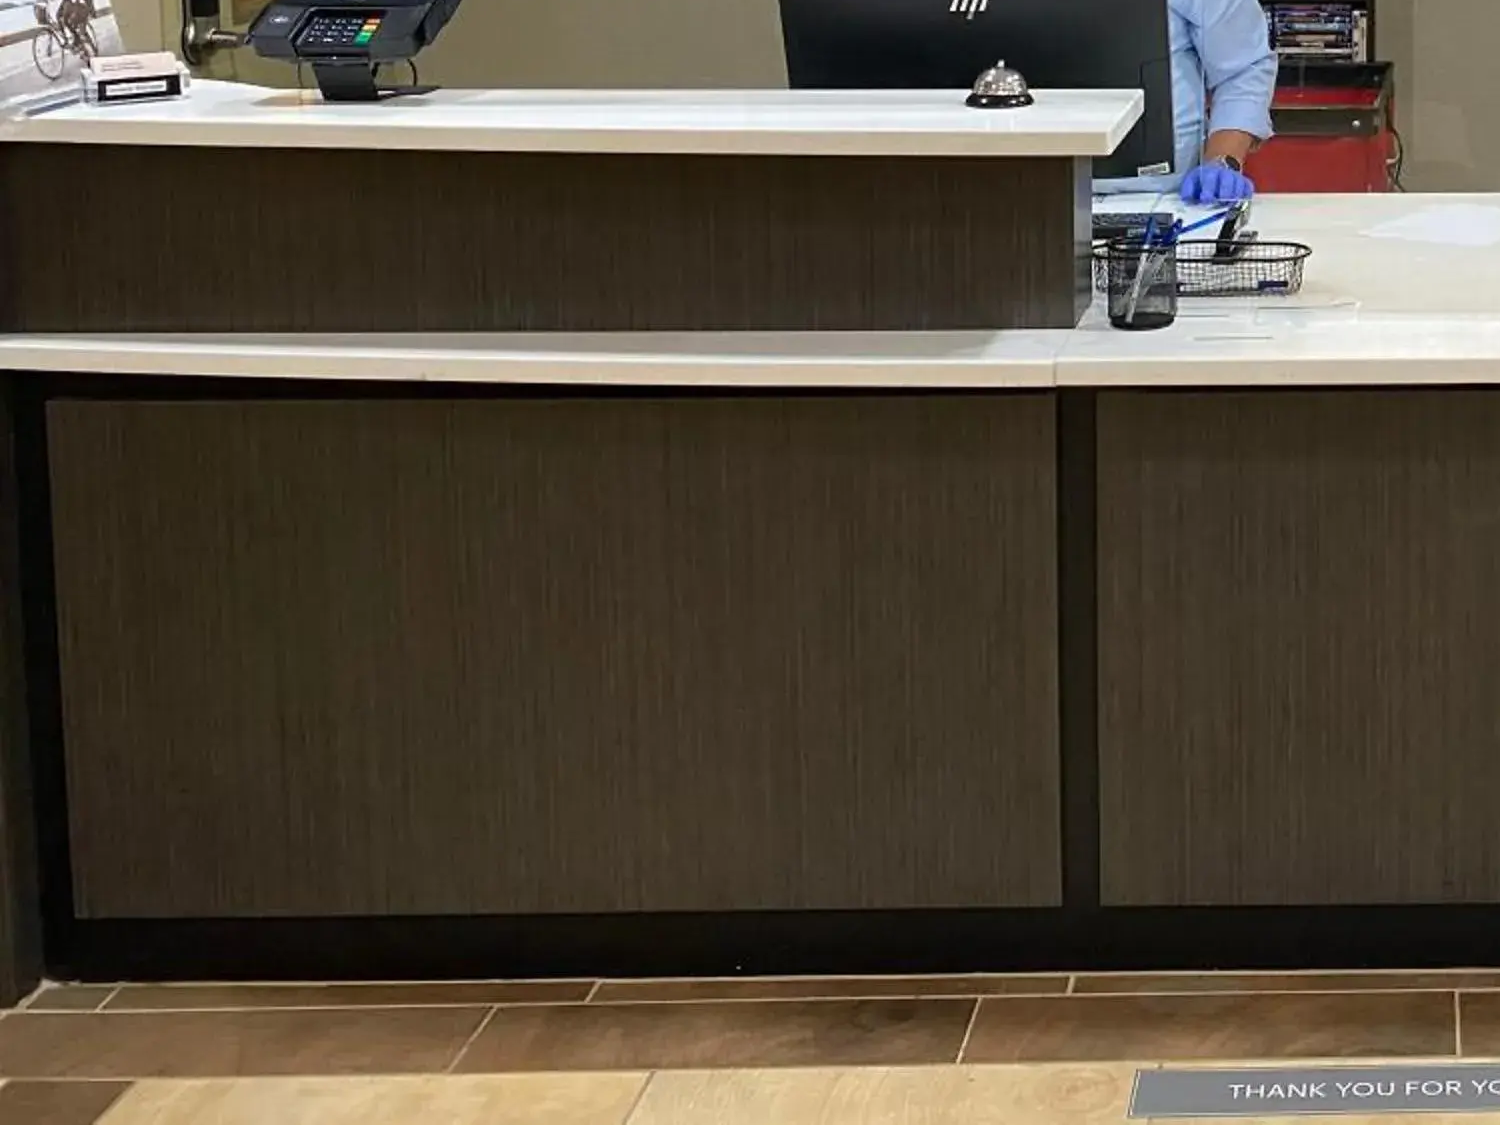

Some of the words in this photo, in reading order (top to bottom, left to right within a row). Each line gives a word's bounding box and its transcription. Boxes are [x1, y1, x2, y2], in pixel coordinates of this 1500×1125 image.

[1228, 1081, 1327, 1100] THANK
[1335, 1081, 1396, 1098] YOU
[1405, 1079, 1462, 1096] FOR
